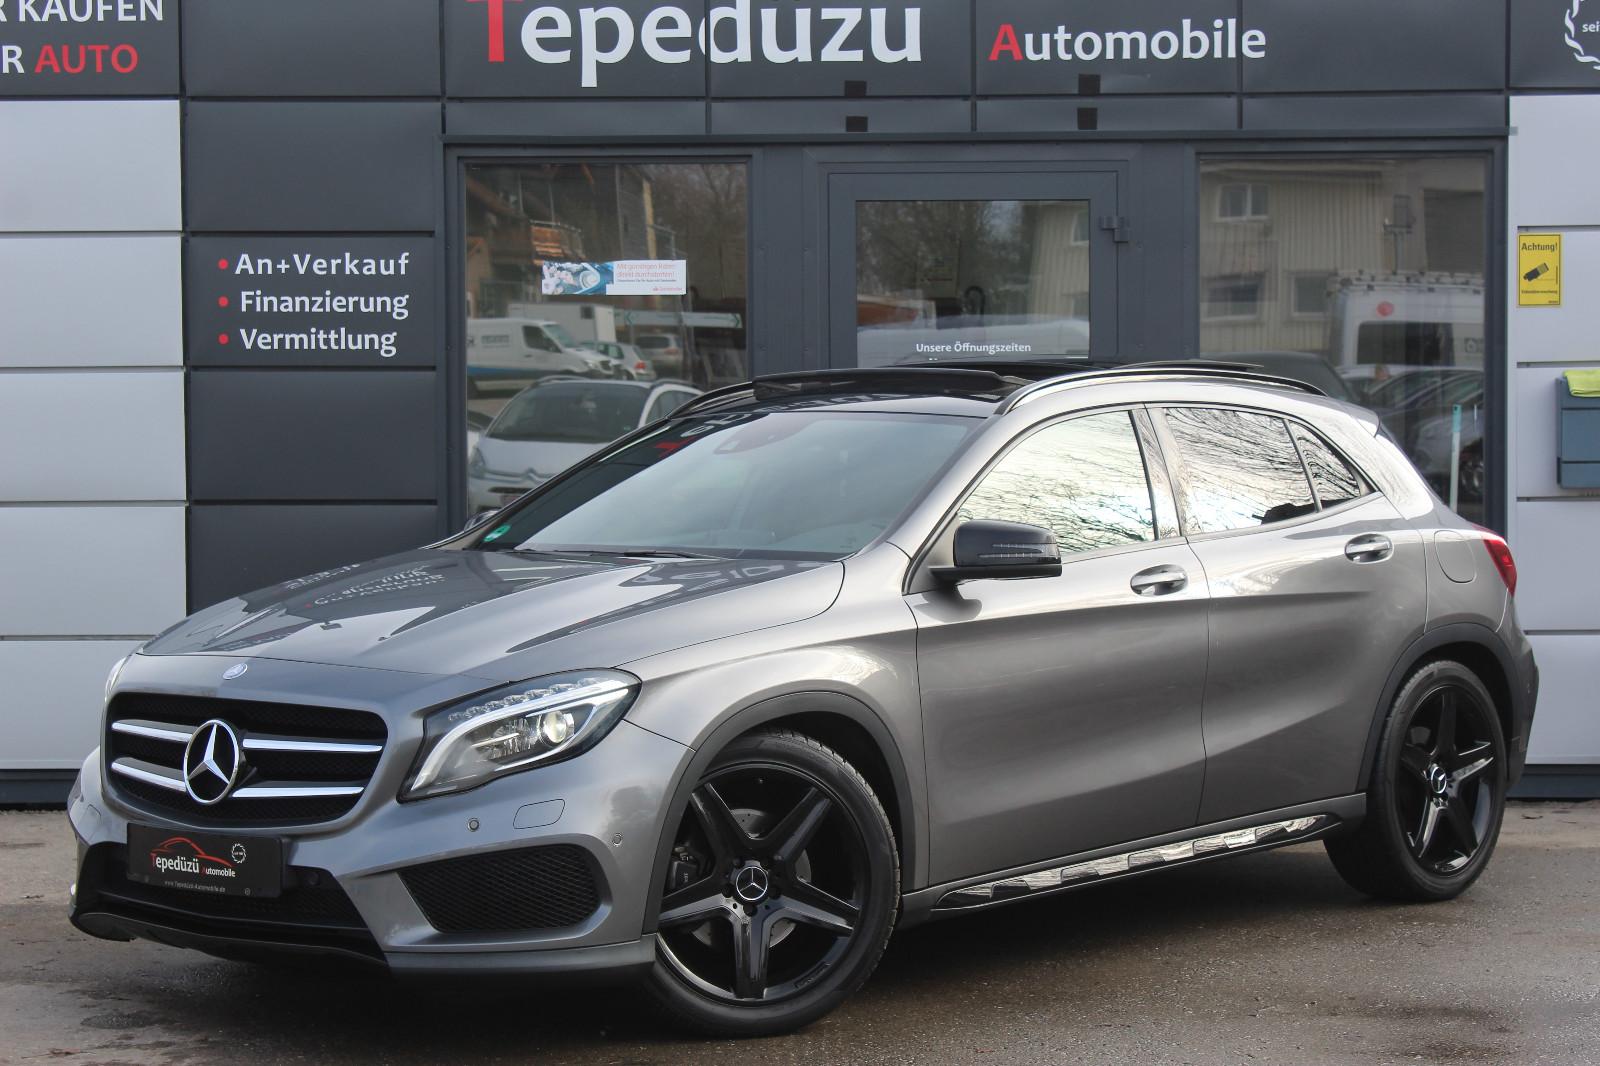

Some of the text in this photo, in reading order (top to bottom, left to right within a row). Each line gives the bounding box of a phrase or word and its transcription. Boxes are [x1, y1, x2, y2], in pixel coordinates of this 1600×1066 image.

[19, 0, 163, 22] KAUFEN
[988, 18, 1266, 61] Automobile
[34, 44, 139, 74] AUTO
[1521, 242, 1558, 252] Achtung!
[235, 252, 409, 275] An+Verkauf
[241, 290, 409, 320] Finanzierung
[240, 327, 397, 357] Vermittlung
[916, 341, 1031, 354] Unsere Öffnungszeiten
[150, 852, 236, 878] Tepedüzü Automobile
